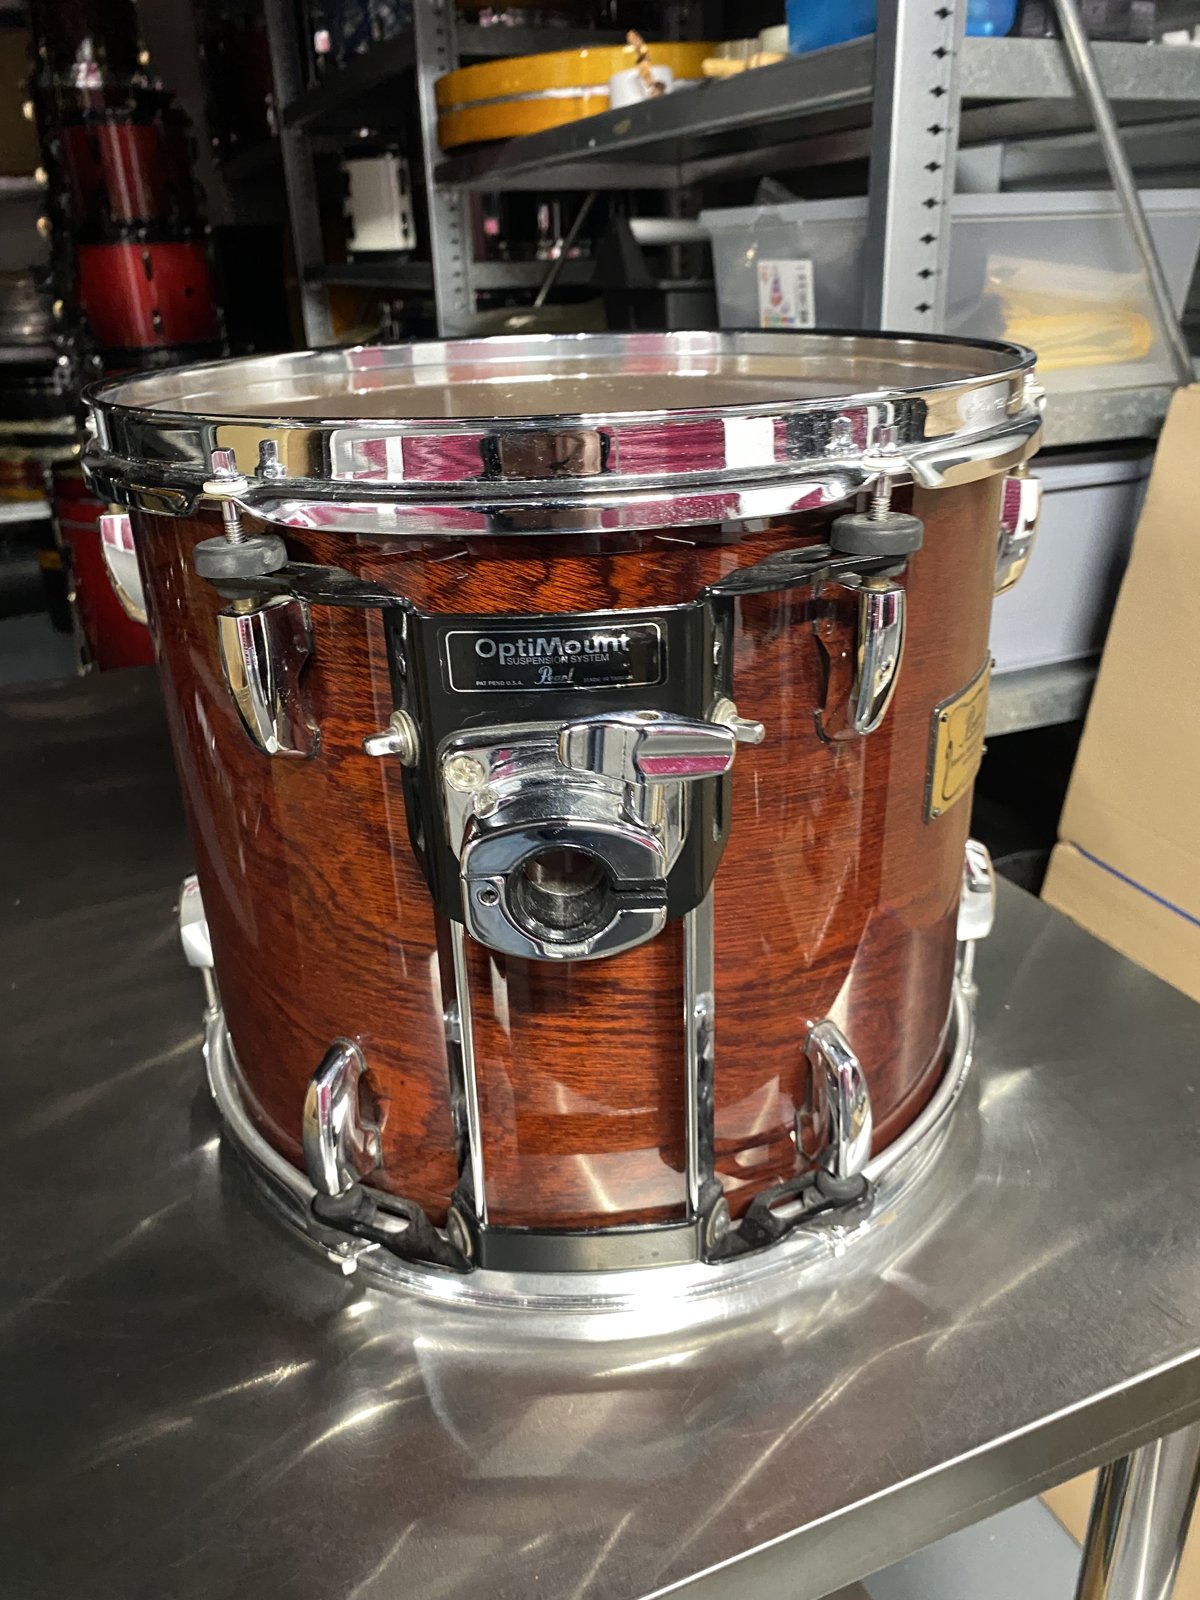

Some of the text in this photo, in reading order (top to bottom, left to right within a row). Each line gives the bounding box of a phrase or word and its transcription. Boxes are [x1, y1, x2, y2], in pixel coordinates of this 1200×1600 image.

[475, 633, 631, 665] OptiMount
[506, 653, 610, 665] SUSPENSION SYSTEM
[534, 665, 575, 685] Pearl
